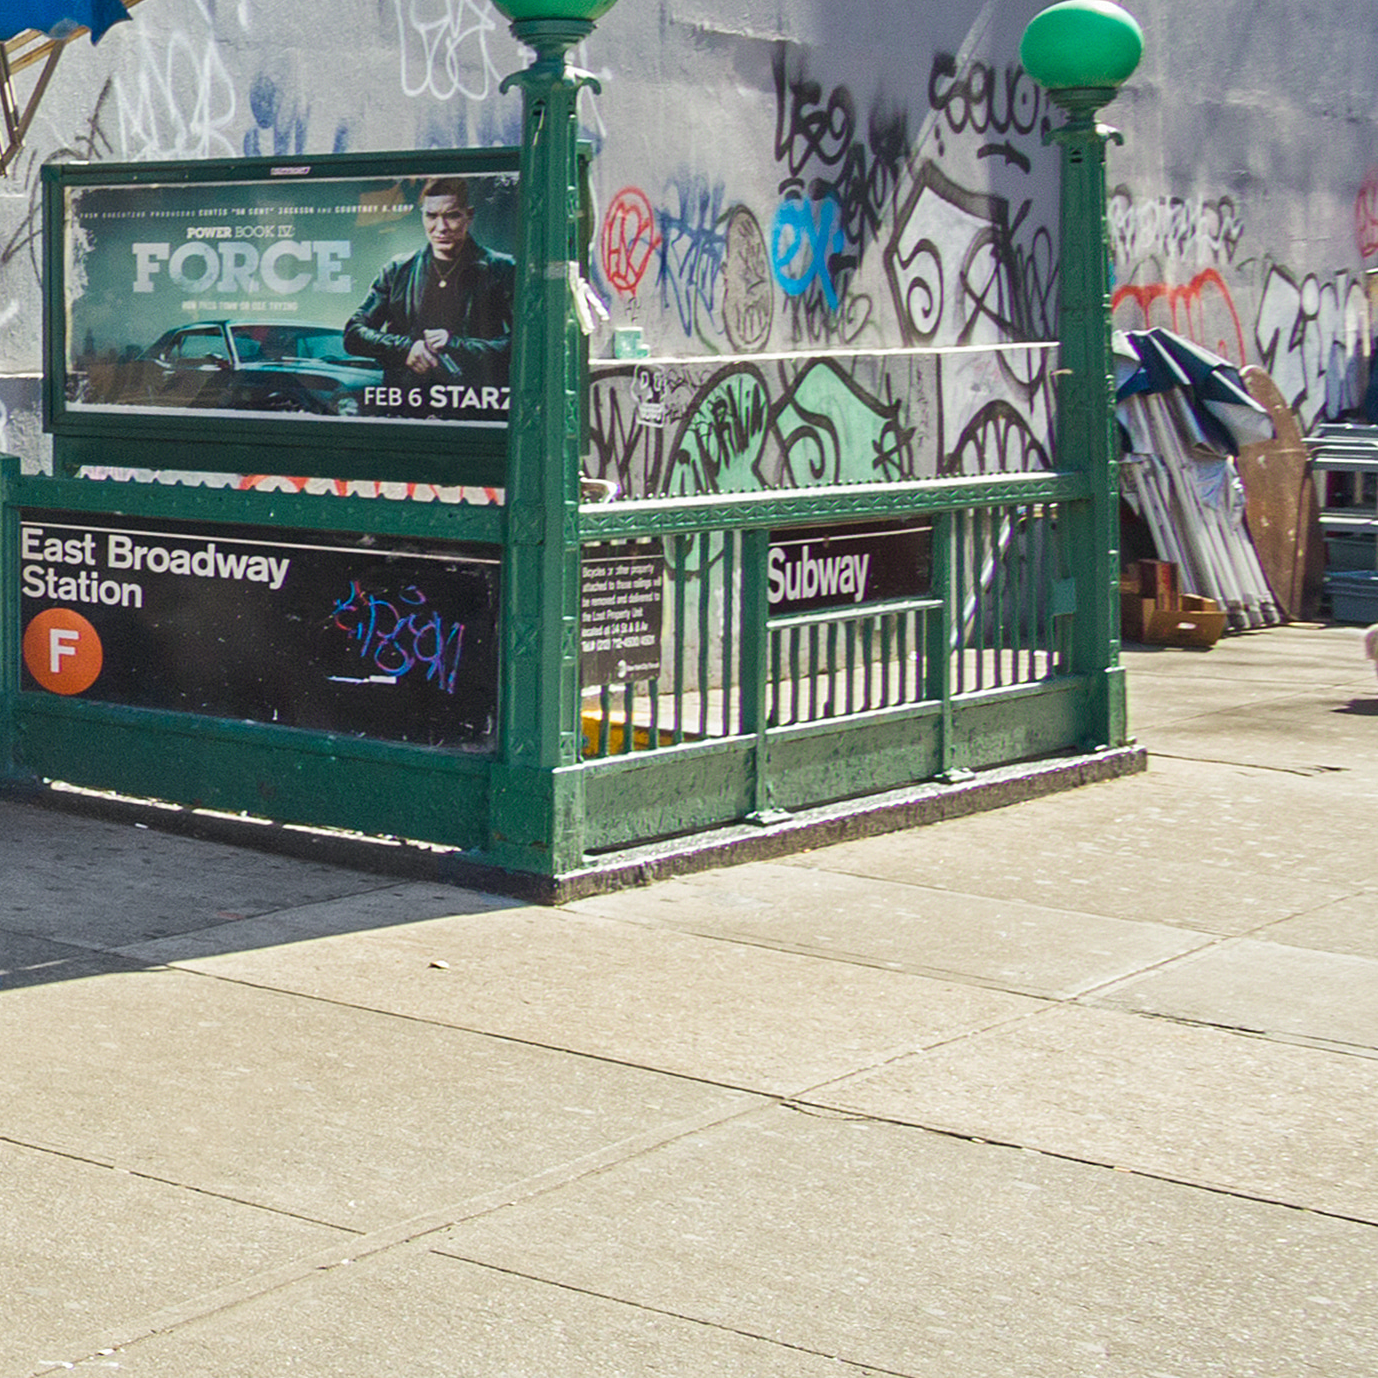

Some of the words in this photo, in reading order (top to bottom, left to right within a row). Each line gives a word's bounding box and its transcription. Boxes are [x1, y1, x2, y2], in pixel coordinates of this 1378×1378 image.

[186, 226, 233, 239] POWER
[234, 225, 276, 238] BOOK
[132, 240, 352, 294] FORCE
[364, 386, 402, 407] FEB
[407, 386, 422, 407] 6
[21, 527, 95, 568] East
[107, 534, 289, 589] Broadway
[767, 544, 870, 603] Subway
[21, 567, 143, 609] Station
[591, 594, 616, 606] removed
[616, 593, 628, 605] and
[606, 609, 631, 620] Property
[49, 627, 79, 673] F
